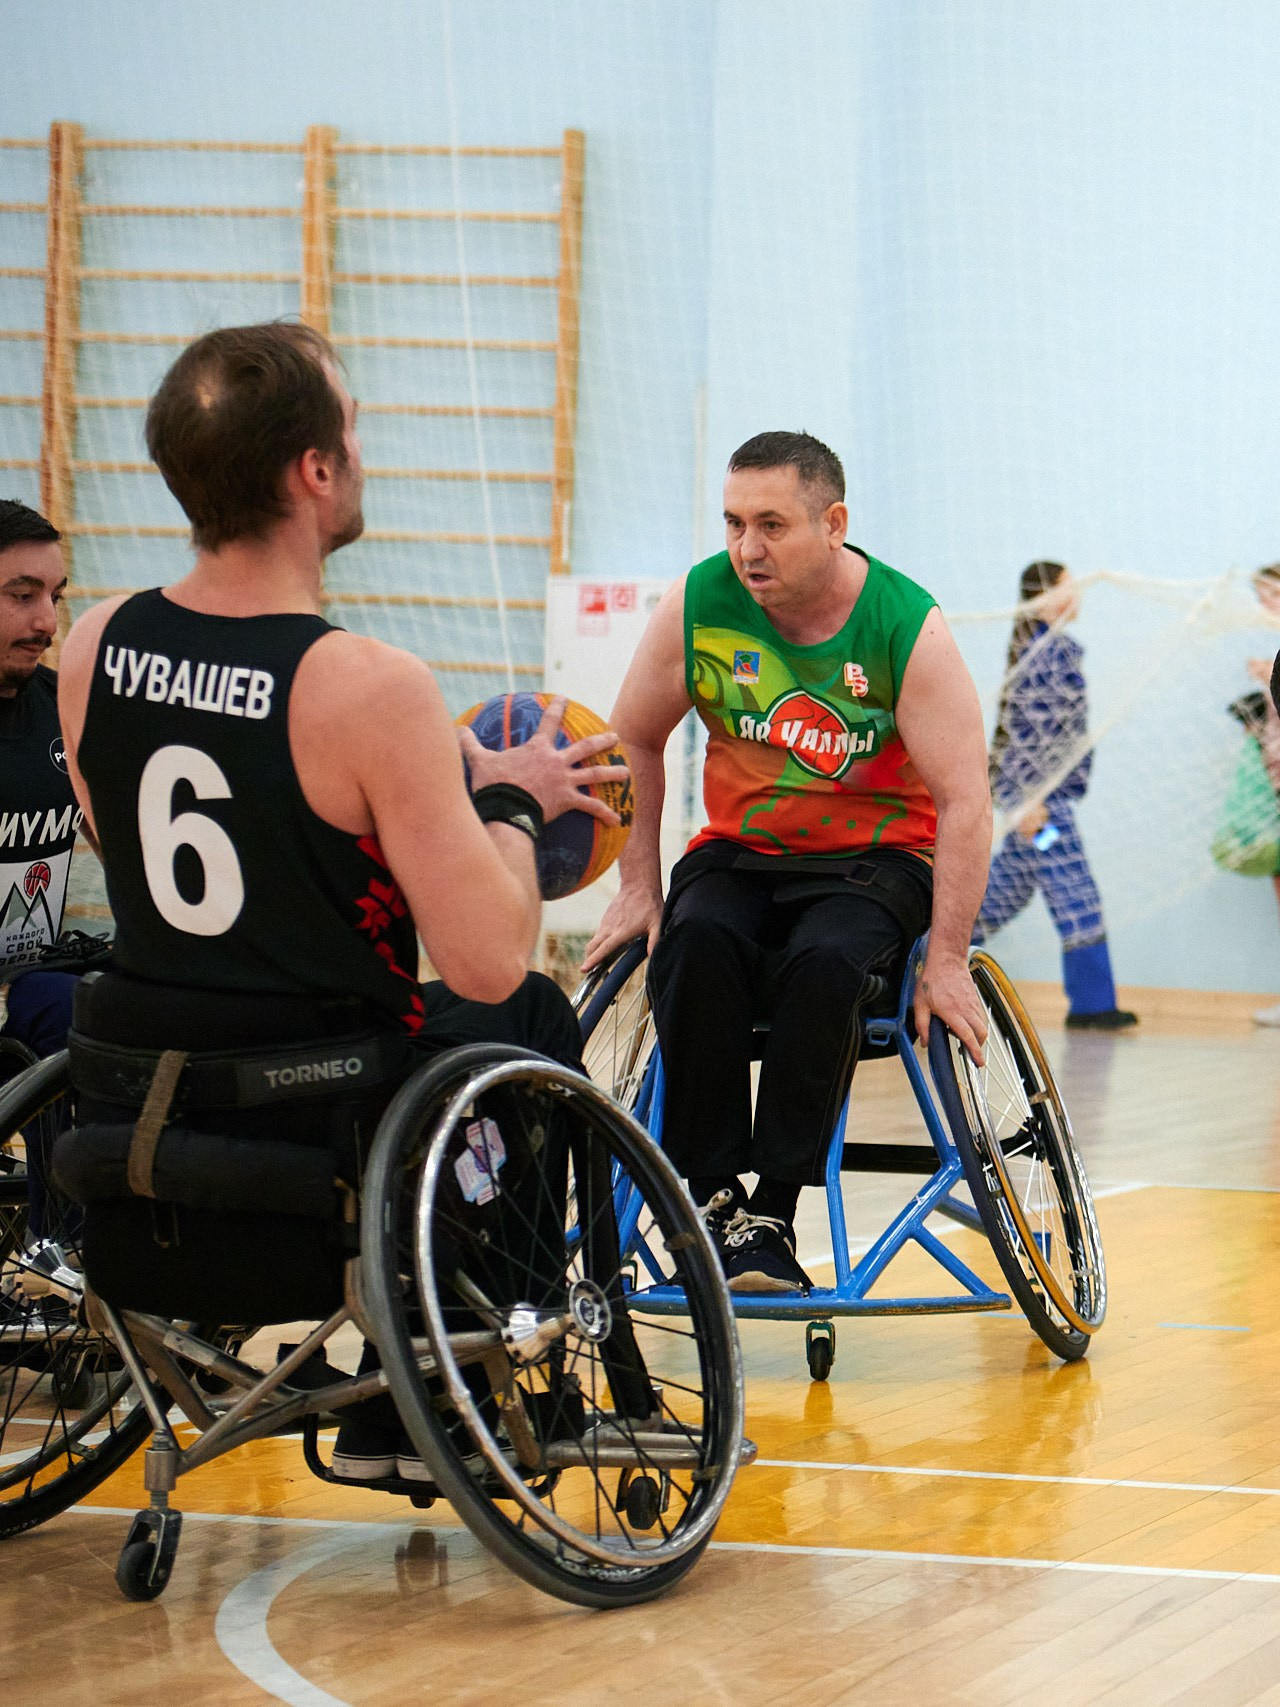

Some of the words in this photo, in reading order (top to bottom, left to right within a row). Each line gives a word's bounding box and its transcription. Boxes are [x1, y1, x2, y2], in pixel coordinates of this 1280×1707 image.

[104, 645, 274, 720] ЧУВАШЕВ
[137, 745, 245, 936] 6
[6, 928, 45, 942] КАЖДОГО
[6, 936, 43, 953] СВОЙ
[263, 1057, 362, 1088] TORNEO
